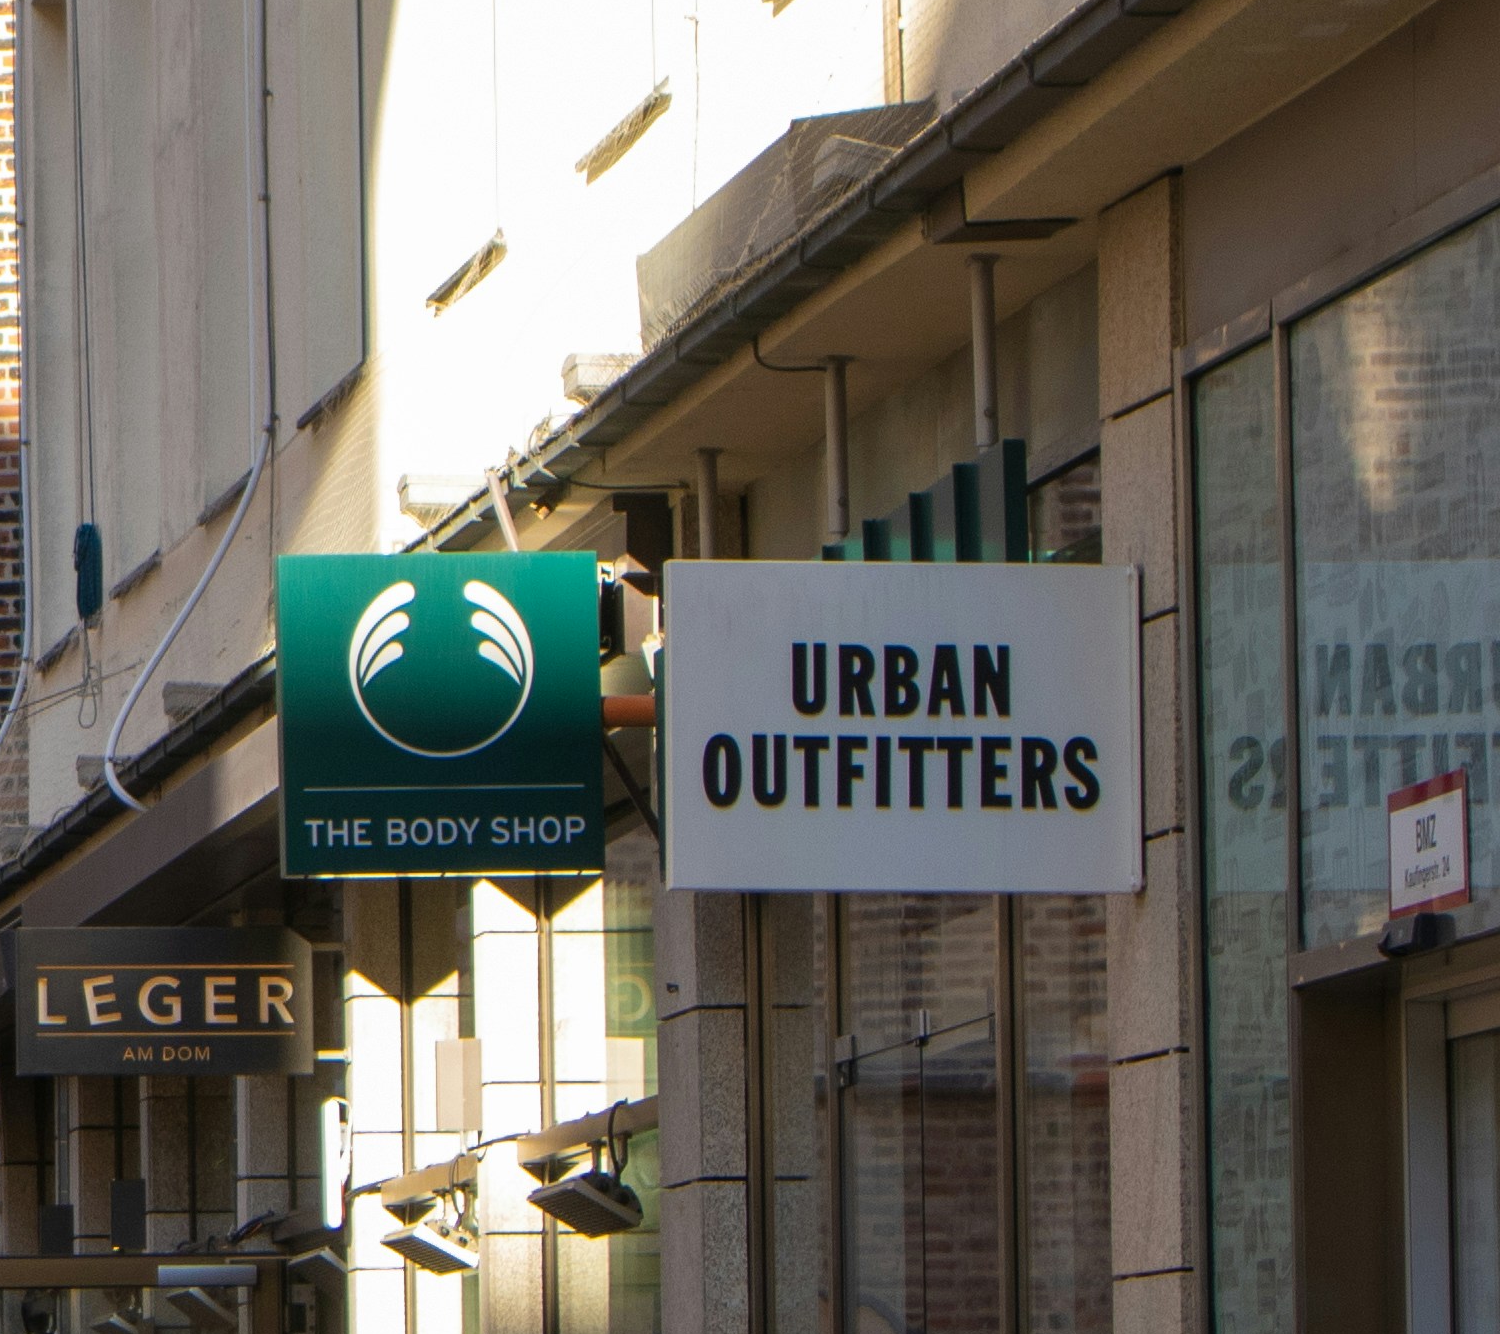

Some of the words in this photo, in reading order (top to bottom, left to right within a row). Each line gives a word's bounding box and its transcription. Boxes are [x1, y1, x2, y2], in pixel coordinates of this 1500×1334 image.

[790, 642, 1011, 718] URBAN
[701, 734, 1101, 810] OUTFITTERS
[304, 819, 373, 847] THE
[385, 818, 480, 846] BODY
[490, 816, 586, 845] SHOP
[1415, 814, 1437, 854] BMZ
[37, 975, 296, 1025] LEGER
[122, 1046, 154, 1062] AM
[162, 1046, 211, 1062] DOM
